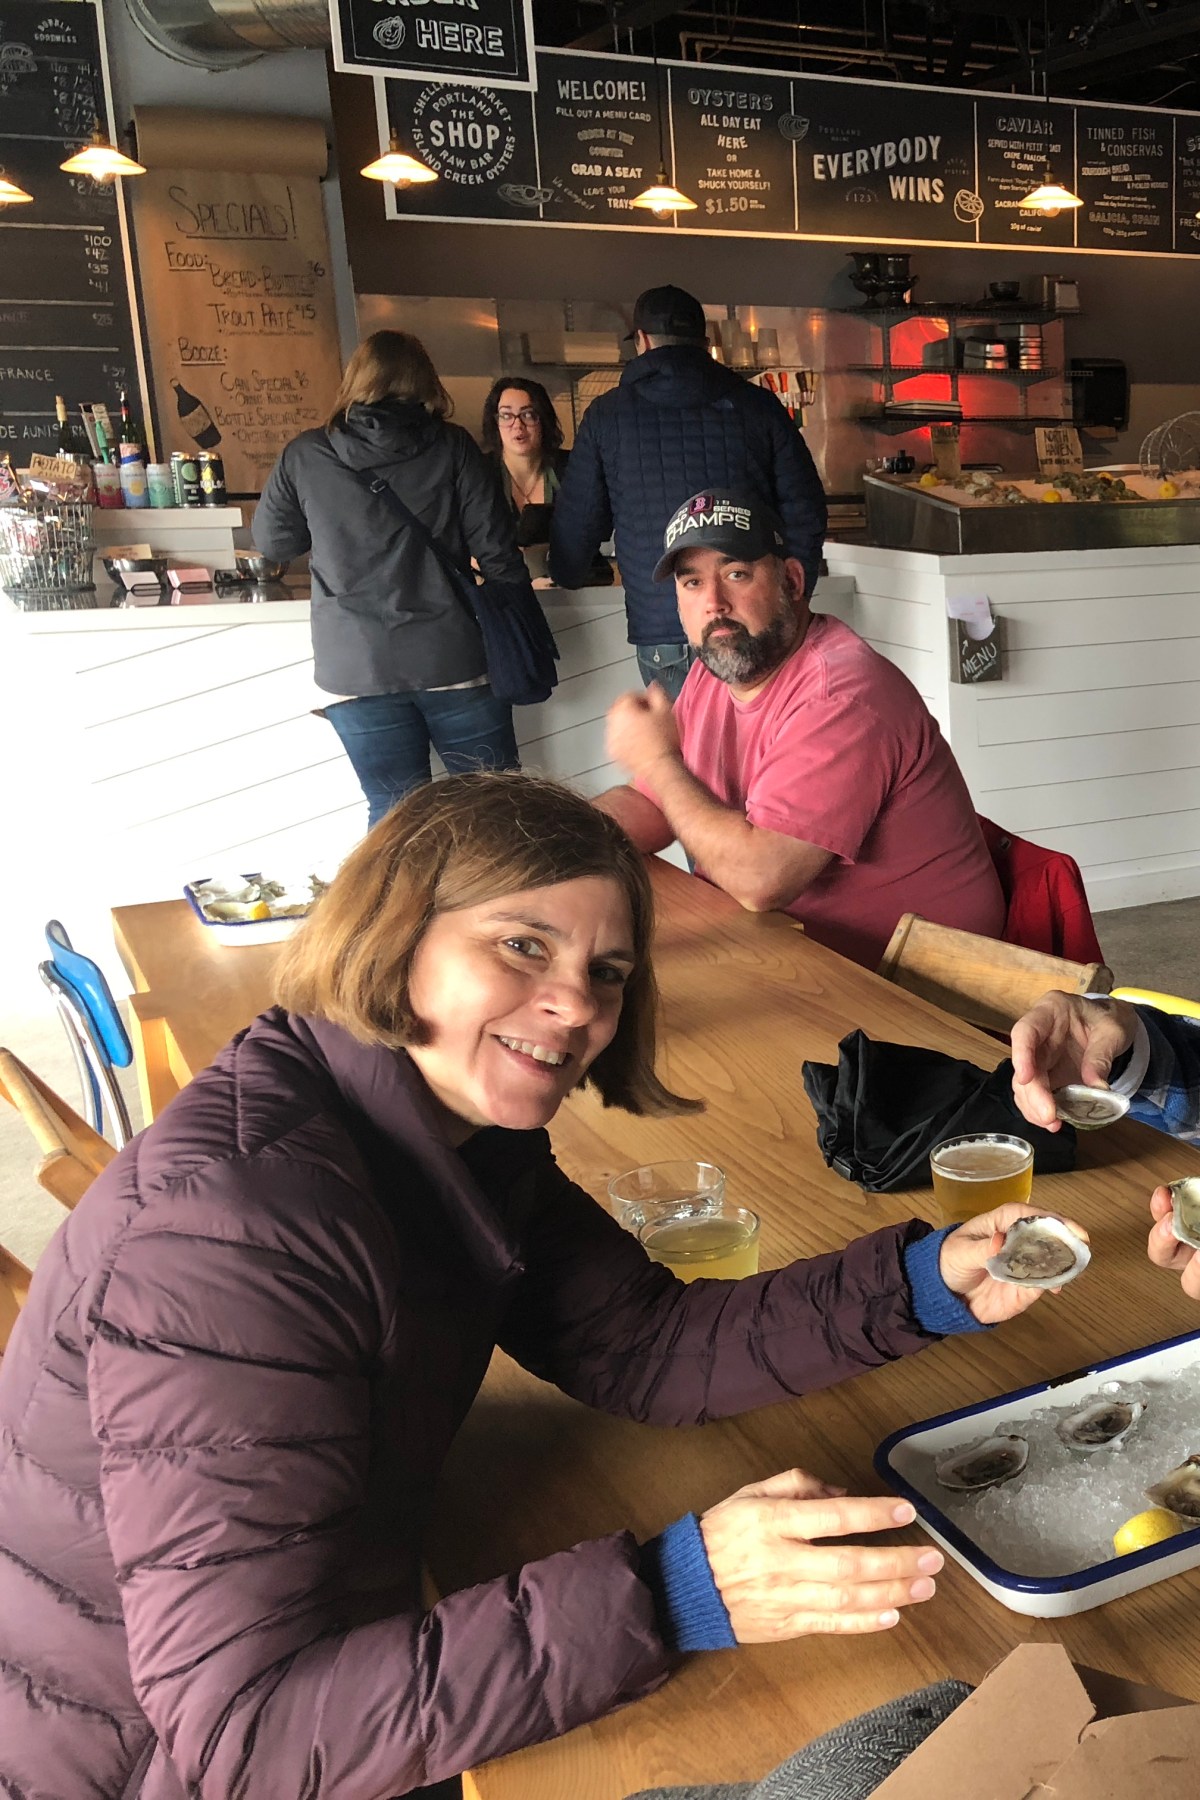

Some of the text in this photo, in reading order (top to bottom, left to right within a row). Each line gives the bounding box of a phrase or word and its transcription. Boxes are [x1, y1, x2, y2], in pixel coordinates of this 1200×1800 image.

[415, 18, 505, 57] HERE
[413, 82, 467, 116] SHELLF
[557, 79, 647, 102] WELCOME!
[687, 88, 774, 111] OYSTERS
[432, 92, 492, 117] PORTLAND
[451, 109, 475, 120] THE
[556, 106, 652, 122] FILL OUT A MENU CARD
[700, 114, 762, 131] ALL DAY EAT
[995, 117, 1054, 136] CAVIAR
[429, 119, 501, 150] SHOP
[717, 134, 749, 150] HERE
[1087, 127, 1156, 141] TINNED FISH
[412, 128, 516, 185] ISLAND CREEK OYSTERS
[439, 149, 494, 170] RAW BAR
[726, 153, 738, 163] OR
[813, 135, 942, 181] EVERYBODY
[1100, 142, 1164, 157] & CONSERVAS
[571, 163, 643, 179] GRAB A SEAT
[707, 168, 761, 179] TAKE HOME &
[698, 180, 771, 192] SHUCK YOURSELF!
[888, 174, 945, 204] WINS
[168, 184, 298, 240] SPECIALS!
[705, 196, 749, 215] $1.50
[84, 234, 111, 247] $100
[164, 240, 208, 268] FOOD:
[178, 336, 228, 362] BOOZE:
[713, 505, 751, 516] SERIES
[666, 512, 750, 548] CHAMPS
[962, 642, 997, 678] MENU
